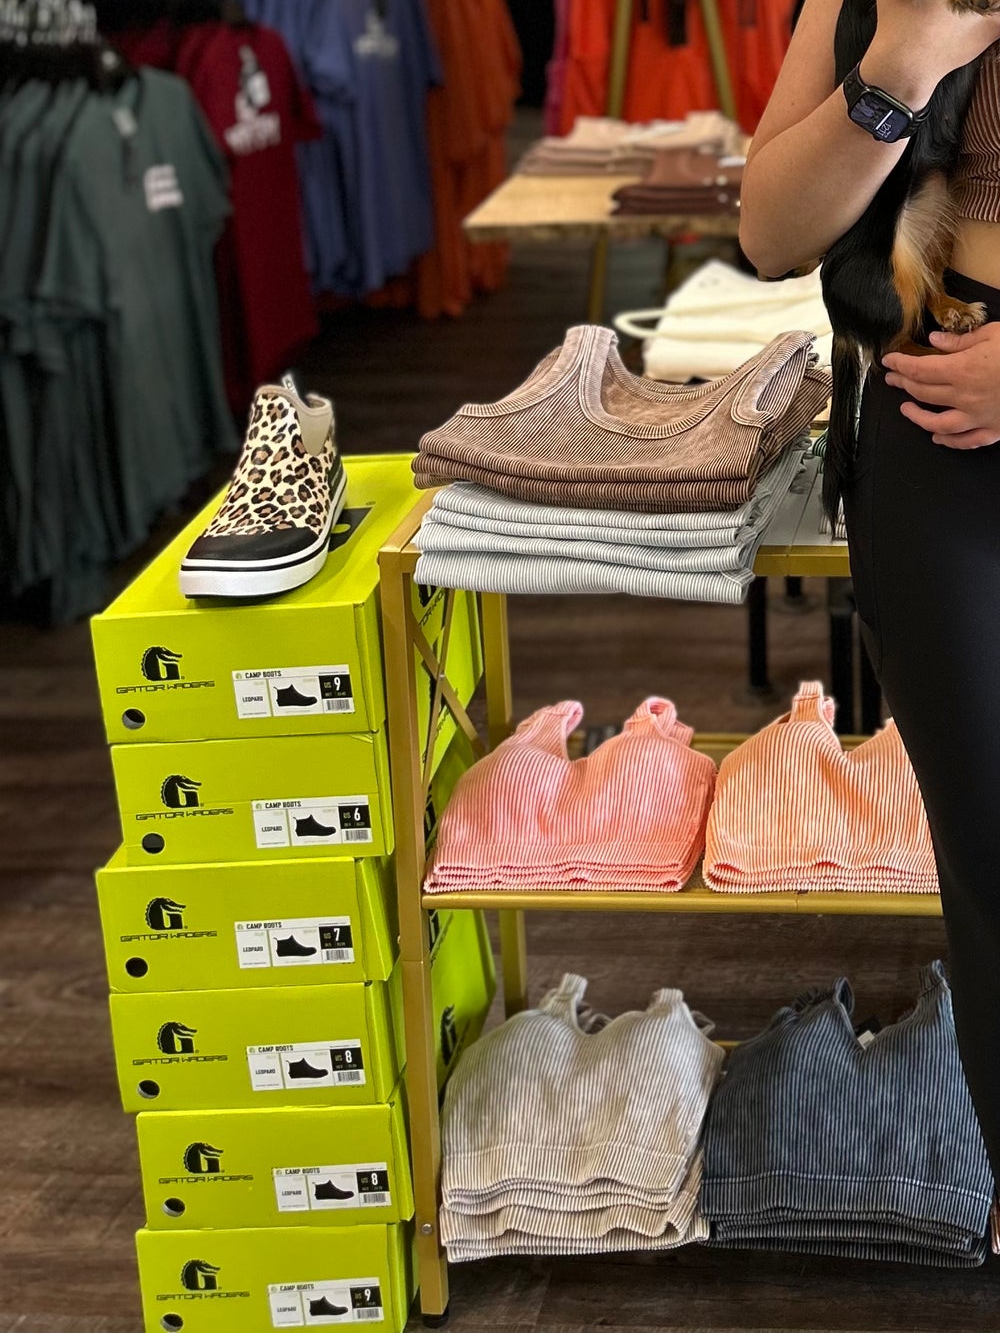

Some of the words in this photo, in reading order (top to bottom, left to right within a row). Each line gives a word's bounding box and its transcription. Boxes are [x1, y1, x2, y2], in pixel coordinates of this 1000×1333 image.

[245, 671, 262, 679] CAMP
[263, 670, 282, 678] BOOTS
[116, 682, 165, 694] GATOR
[166, 680, 215, 692] WADERS
[334, 676, 341, 691] 9
[265, 801, 282, 809] CAMP
[283, 800, 302, 808] BOOTS
[135, 810, 184, 821] GATOR
[185, 807, 234, 818] WADERS
[353, 807, 361, 821] 6
[263, 921, 282, 929] BOOTS
[120, 933, 168, 942] GATOR
[169, 930, 218, 939] WADERS
[333, 927, 340, 942] 7
[345, 1050, 352, 1063] 8
[370, 1172, 378, 1186] 8
